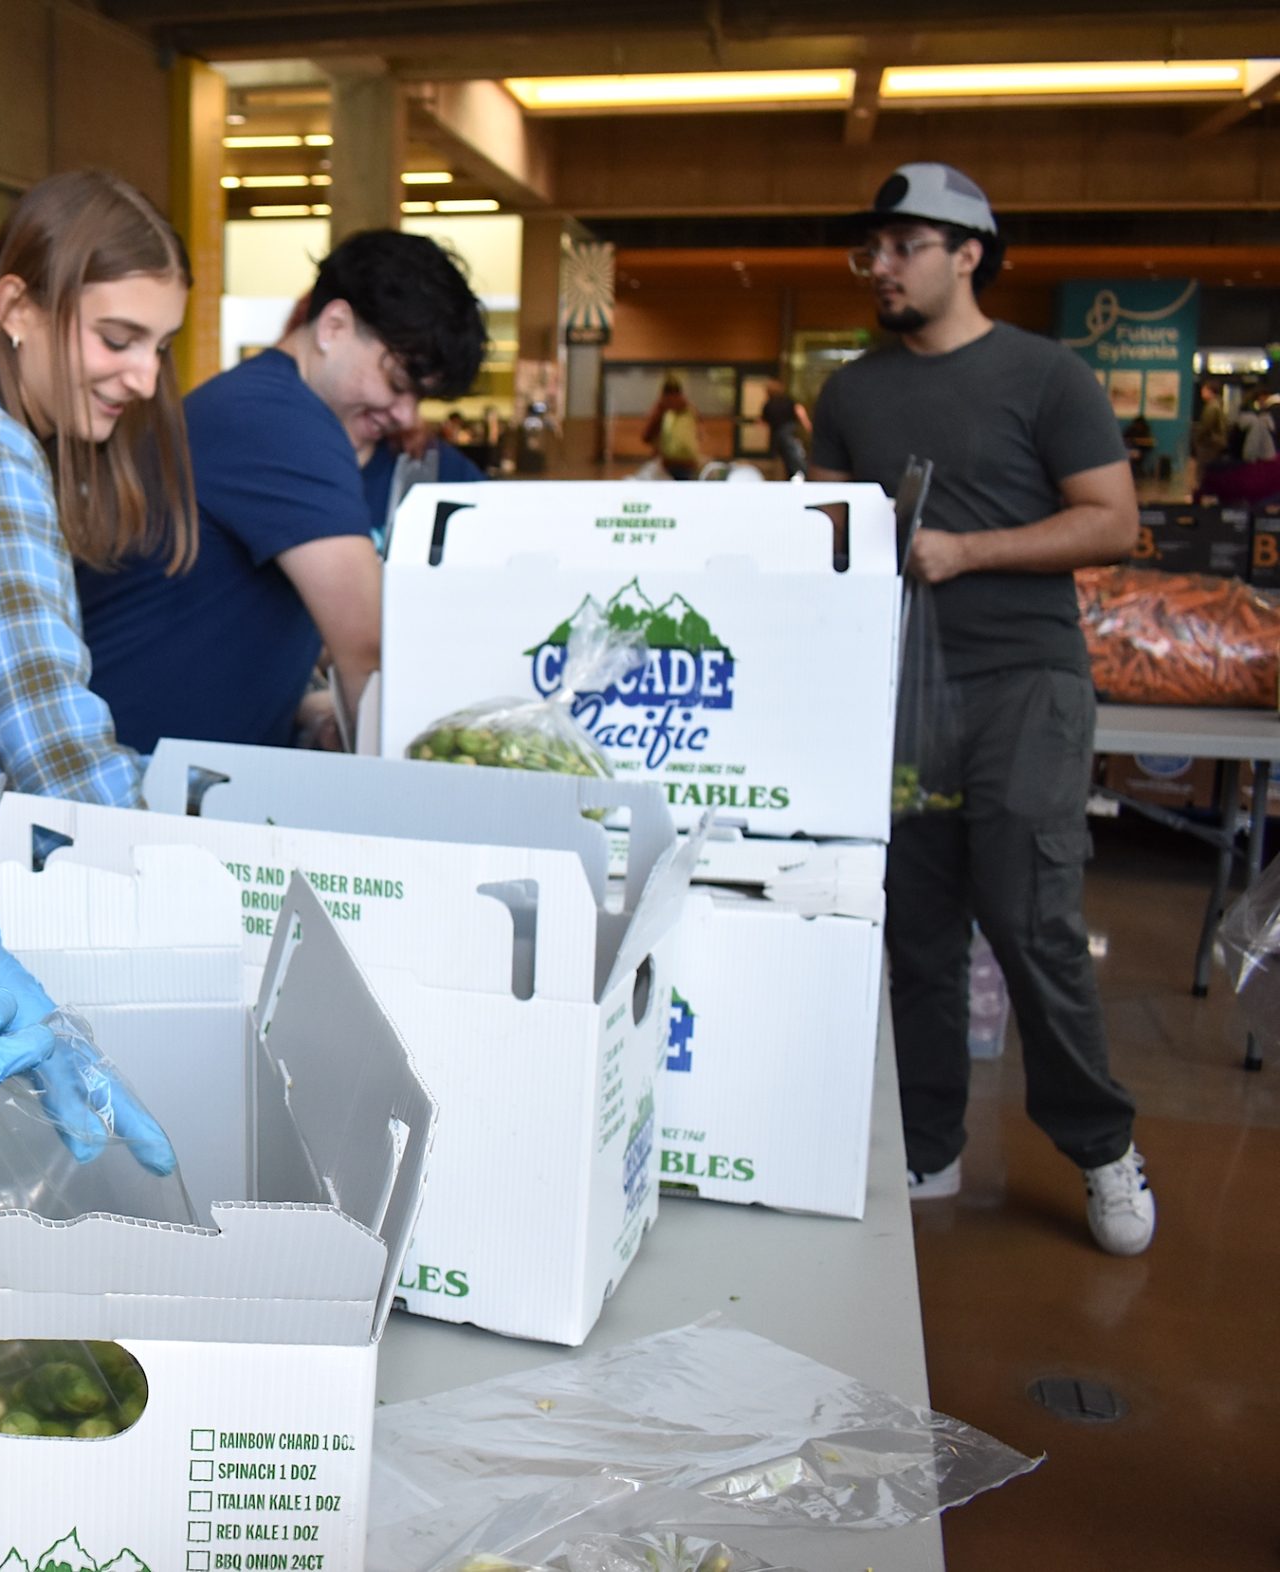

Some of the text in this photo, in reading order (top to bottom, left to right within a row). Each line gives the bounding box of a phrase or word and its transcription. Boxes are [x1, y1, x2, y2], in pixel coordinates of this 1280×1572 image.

[1116, 325, 1179, 343] Future
[1096, 342, 1179, 364] Sylvania
[623, 502, 651, 513] KEEP
[595, 517, 676, 528] REFRIGERATED
[663, 781, 790, 810] TABLES
[256, 866, 284, 886] AND
[353, 876, 404, 900] BANDS
[660, 1149, 755, 1182] BLES
[219, 1432, 276, 1450] RAINBOW
[279, 1433, 319, 1450] CHARD
[322, 1434, 329, 1451] 1
[218, 1463, 317, 1481] SPINACH 1 DOZ
[217, 1494, 341, 1512] ITALIAN KALE 1 DOZ
[216, 1524, 319, 1541] RED KALE 1 DOZ
[215, 1553, 324, 1571] BBQ ONION 24CT
